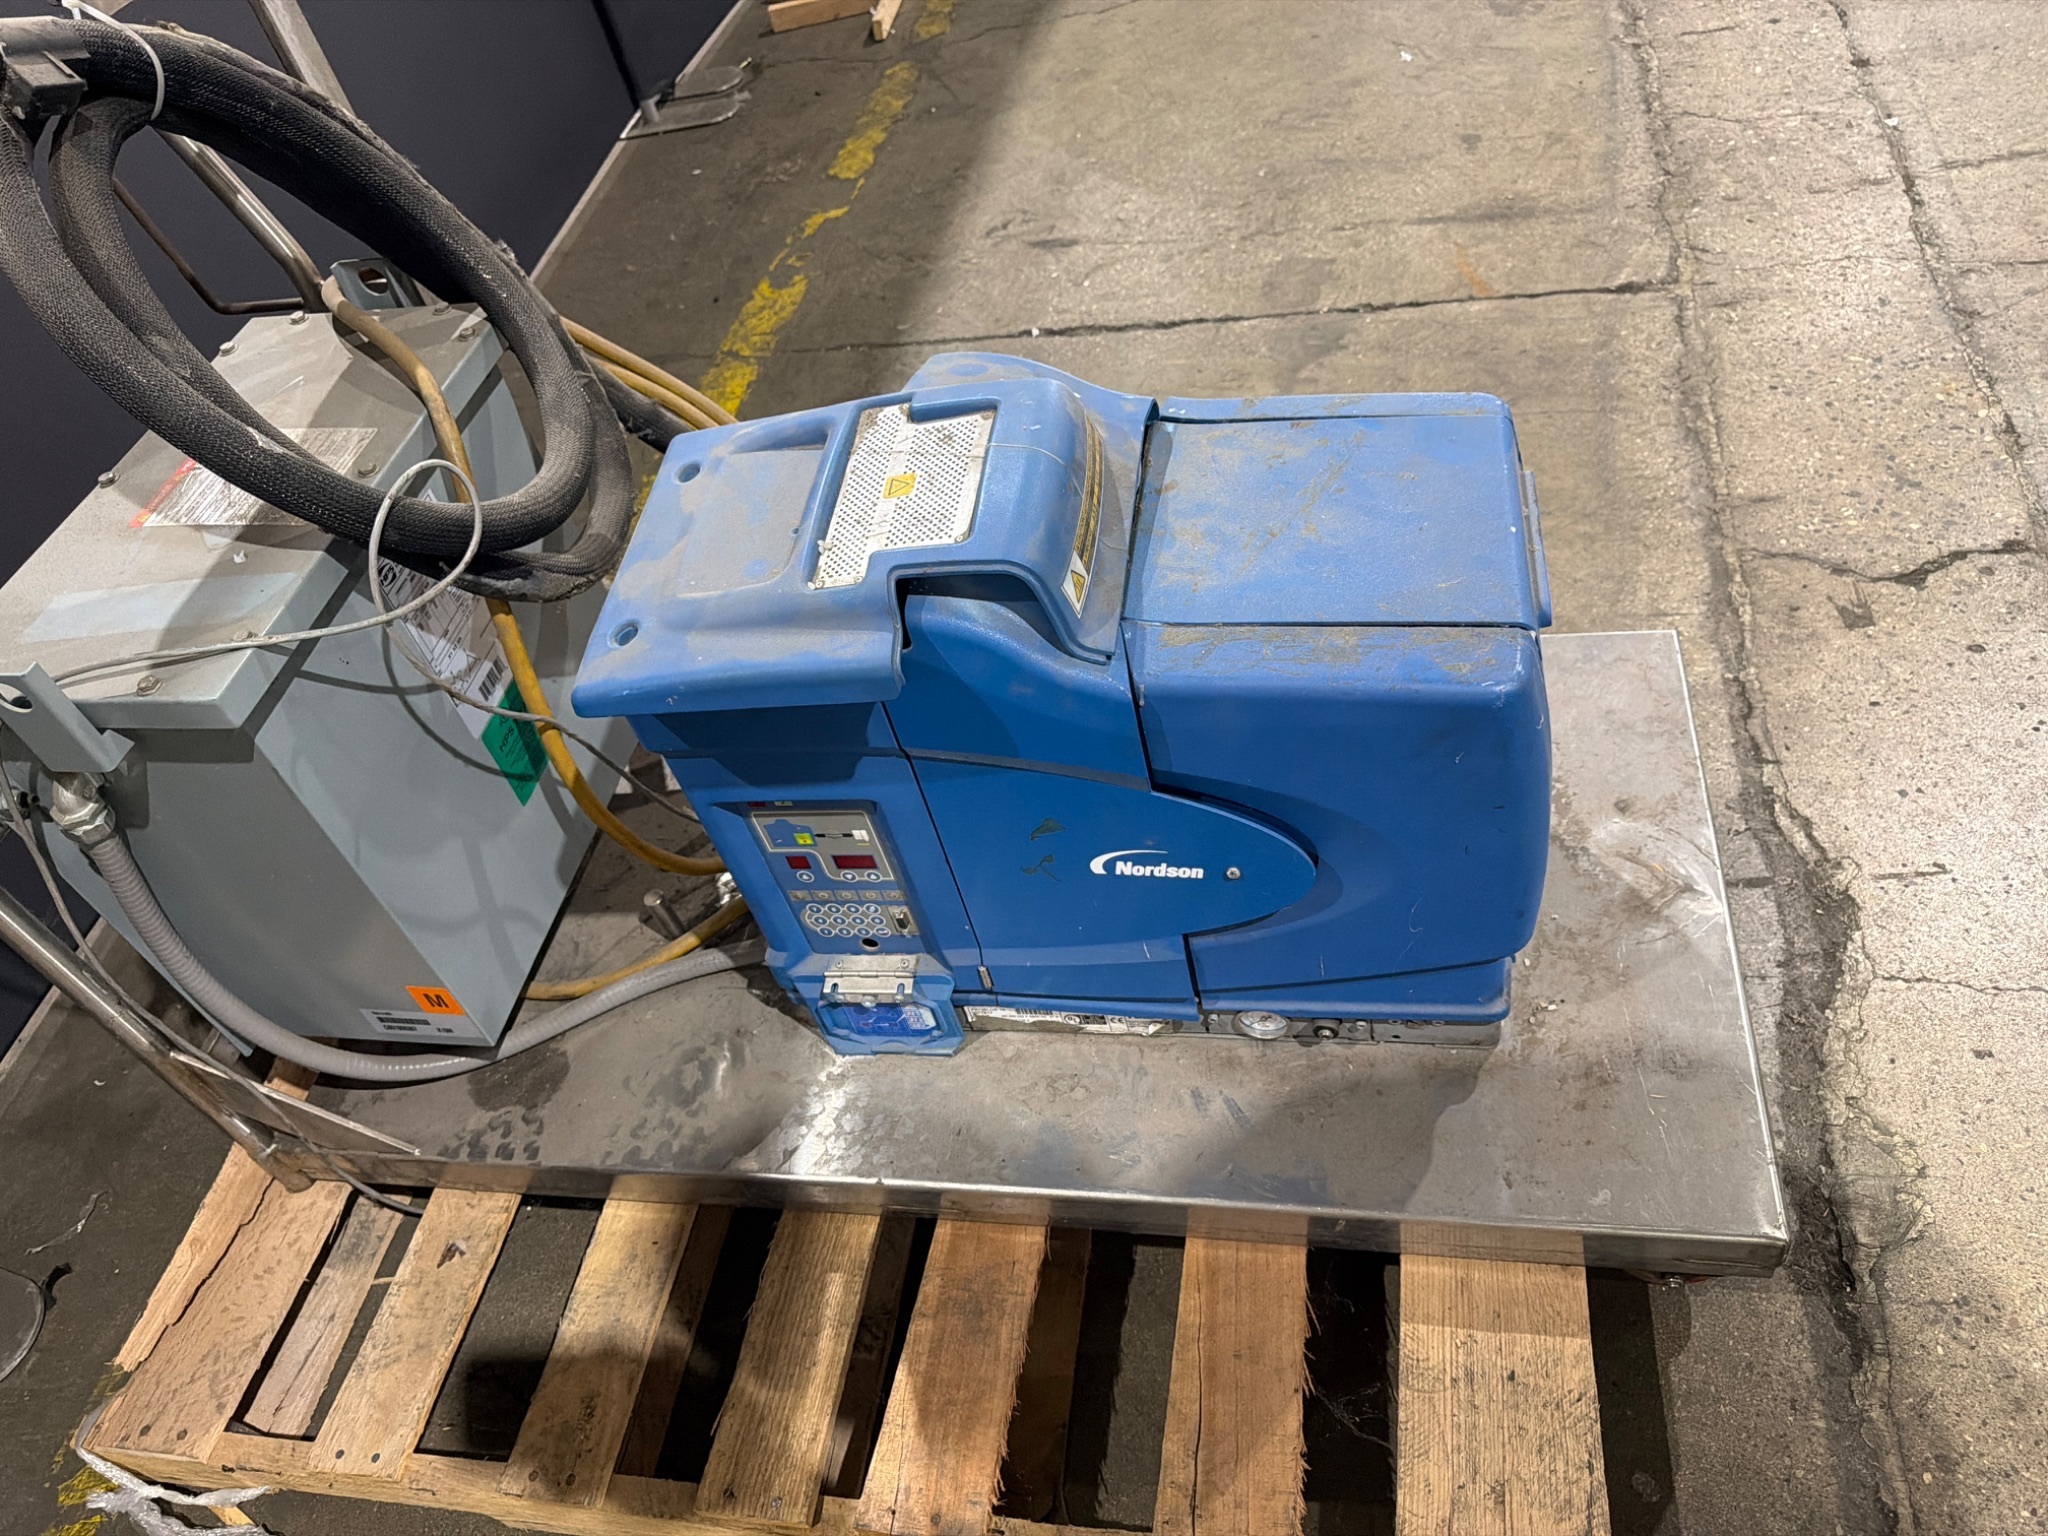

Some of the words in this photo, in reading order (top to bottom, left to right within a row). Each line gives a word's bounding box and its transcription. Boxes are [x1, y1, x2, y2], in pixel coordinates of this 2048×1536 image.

[380, 564, 394, 585] HPS
[499, 725, 514, 752] HPS
[1115, 861, 1204, 879] Nordson
[422, 993, 449, 1008] M
